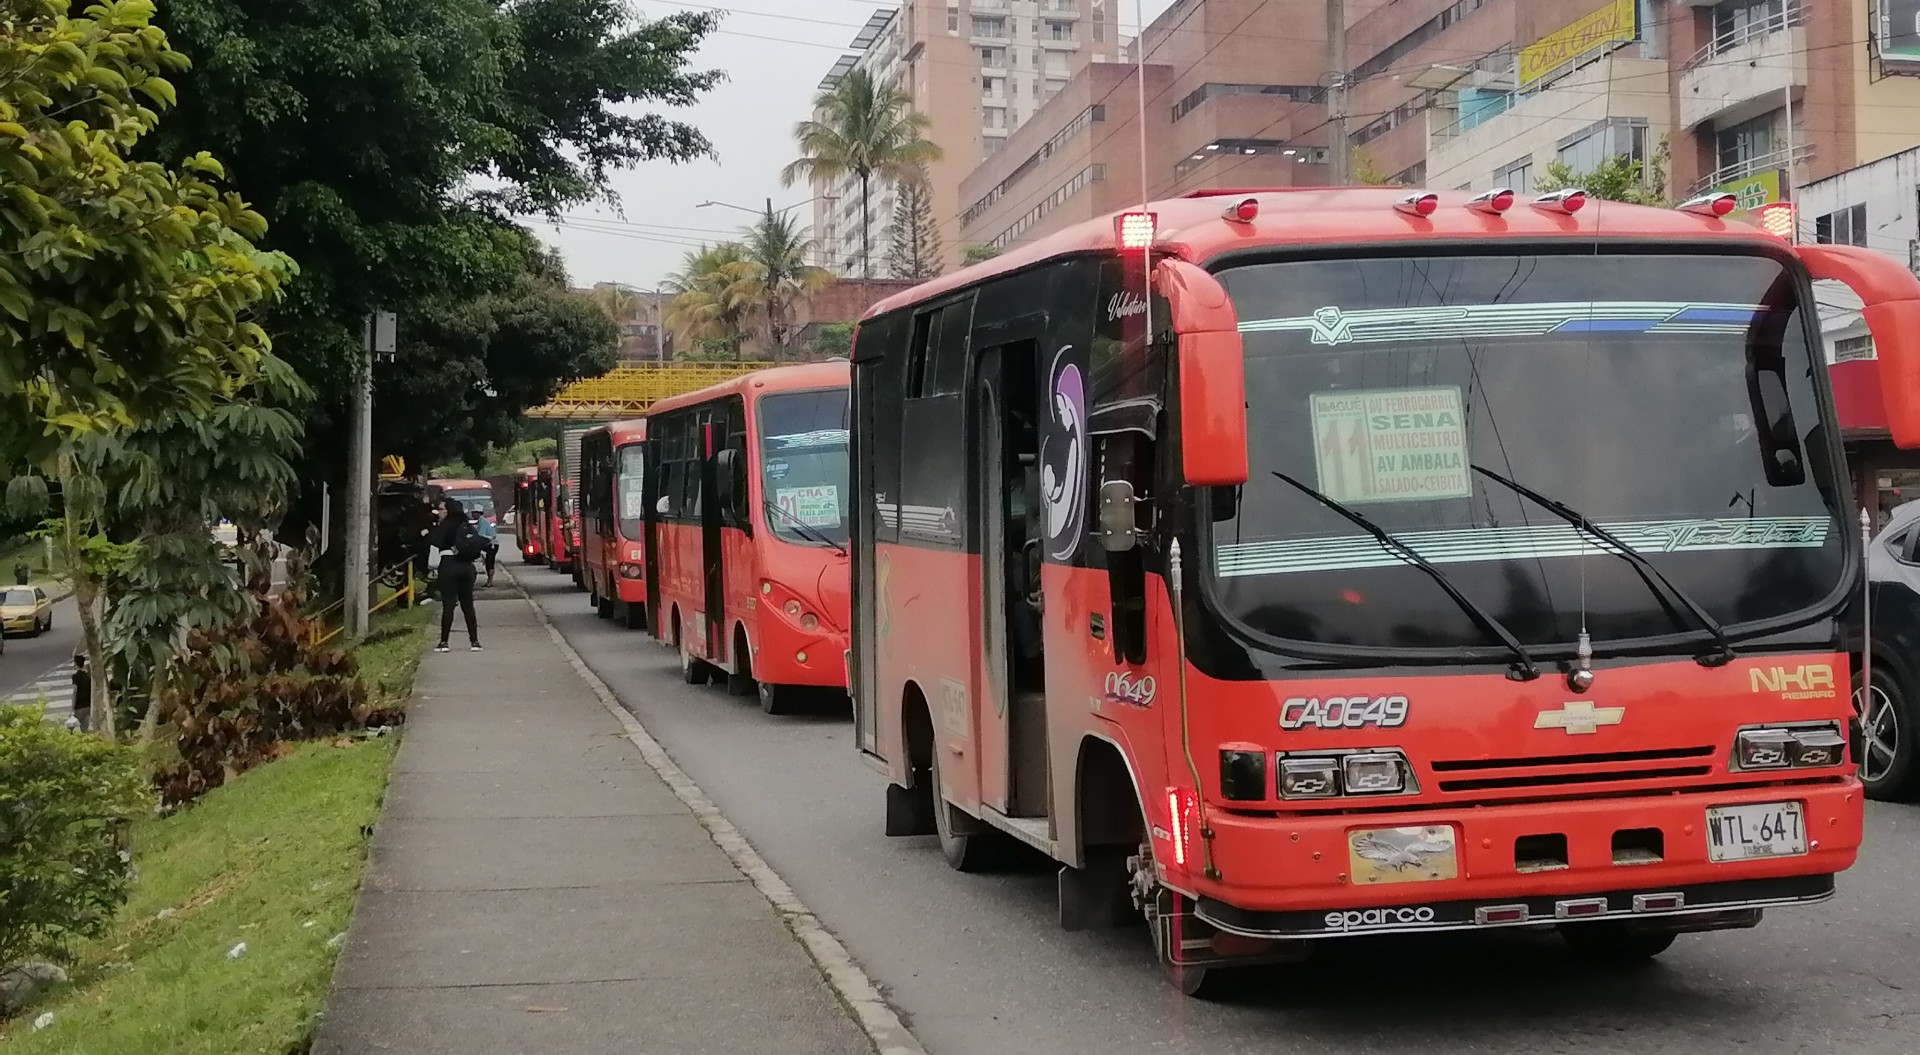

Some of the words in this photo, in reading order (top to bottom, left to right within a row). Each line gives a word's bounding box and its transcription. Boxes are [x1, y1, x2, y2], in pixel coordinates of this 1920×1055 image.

[1529, 41, 1567, 72] CASA
[1571, 8, 1621, 50] CHINA
[1386, 394, 1456, 411] FERROCARRIL
[1372, 412, 1456, 430] SENA
[1373, 431, 1460, 450] MULTICENTRO
[1322, 419, 1372, 498] 11
[1378, 456, 1396, 472] AV
[1401, 452, 1461, 471] AMBALA
[798, 489, 823, 497] CRA
[827, 488, 834, 496] 5
[780, 494, 798, 525] 21
[1104, 671, 1157, 705] 0649
[1750, 665, 1835, 693] NKR
[1782, 690, 1836, 700] REWARD
[1709, 815, 1753, 847] WTL
[1760, 811, 1799, 842] 647
[1325, 907, 1435, 932] sparco
